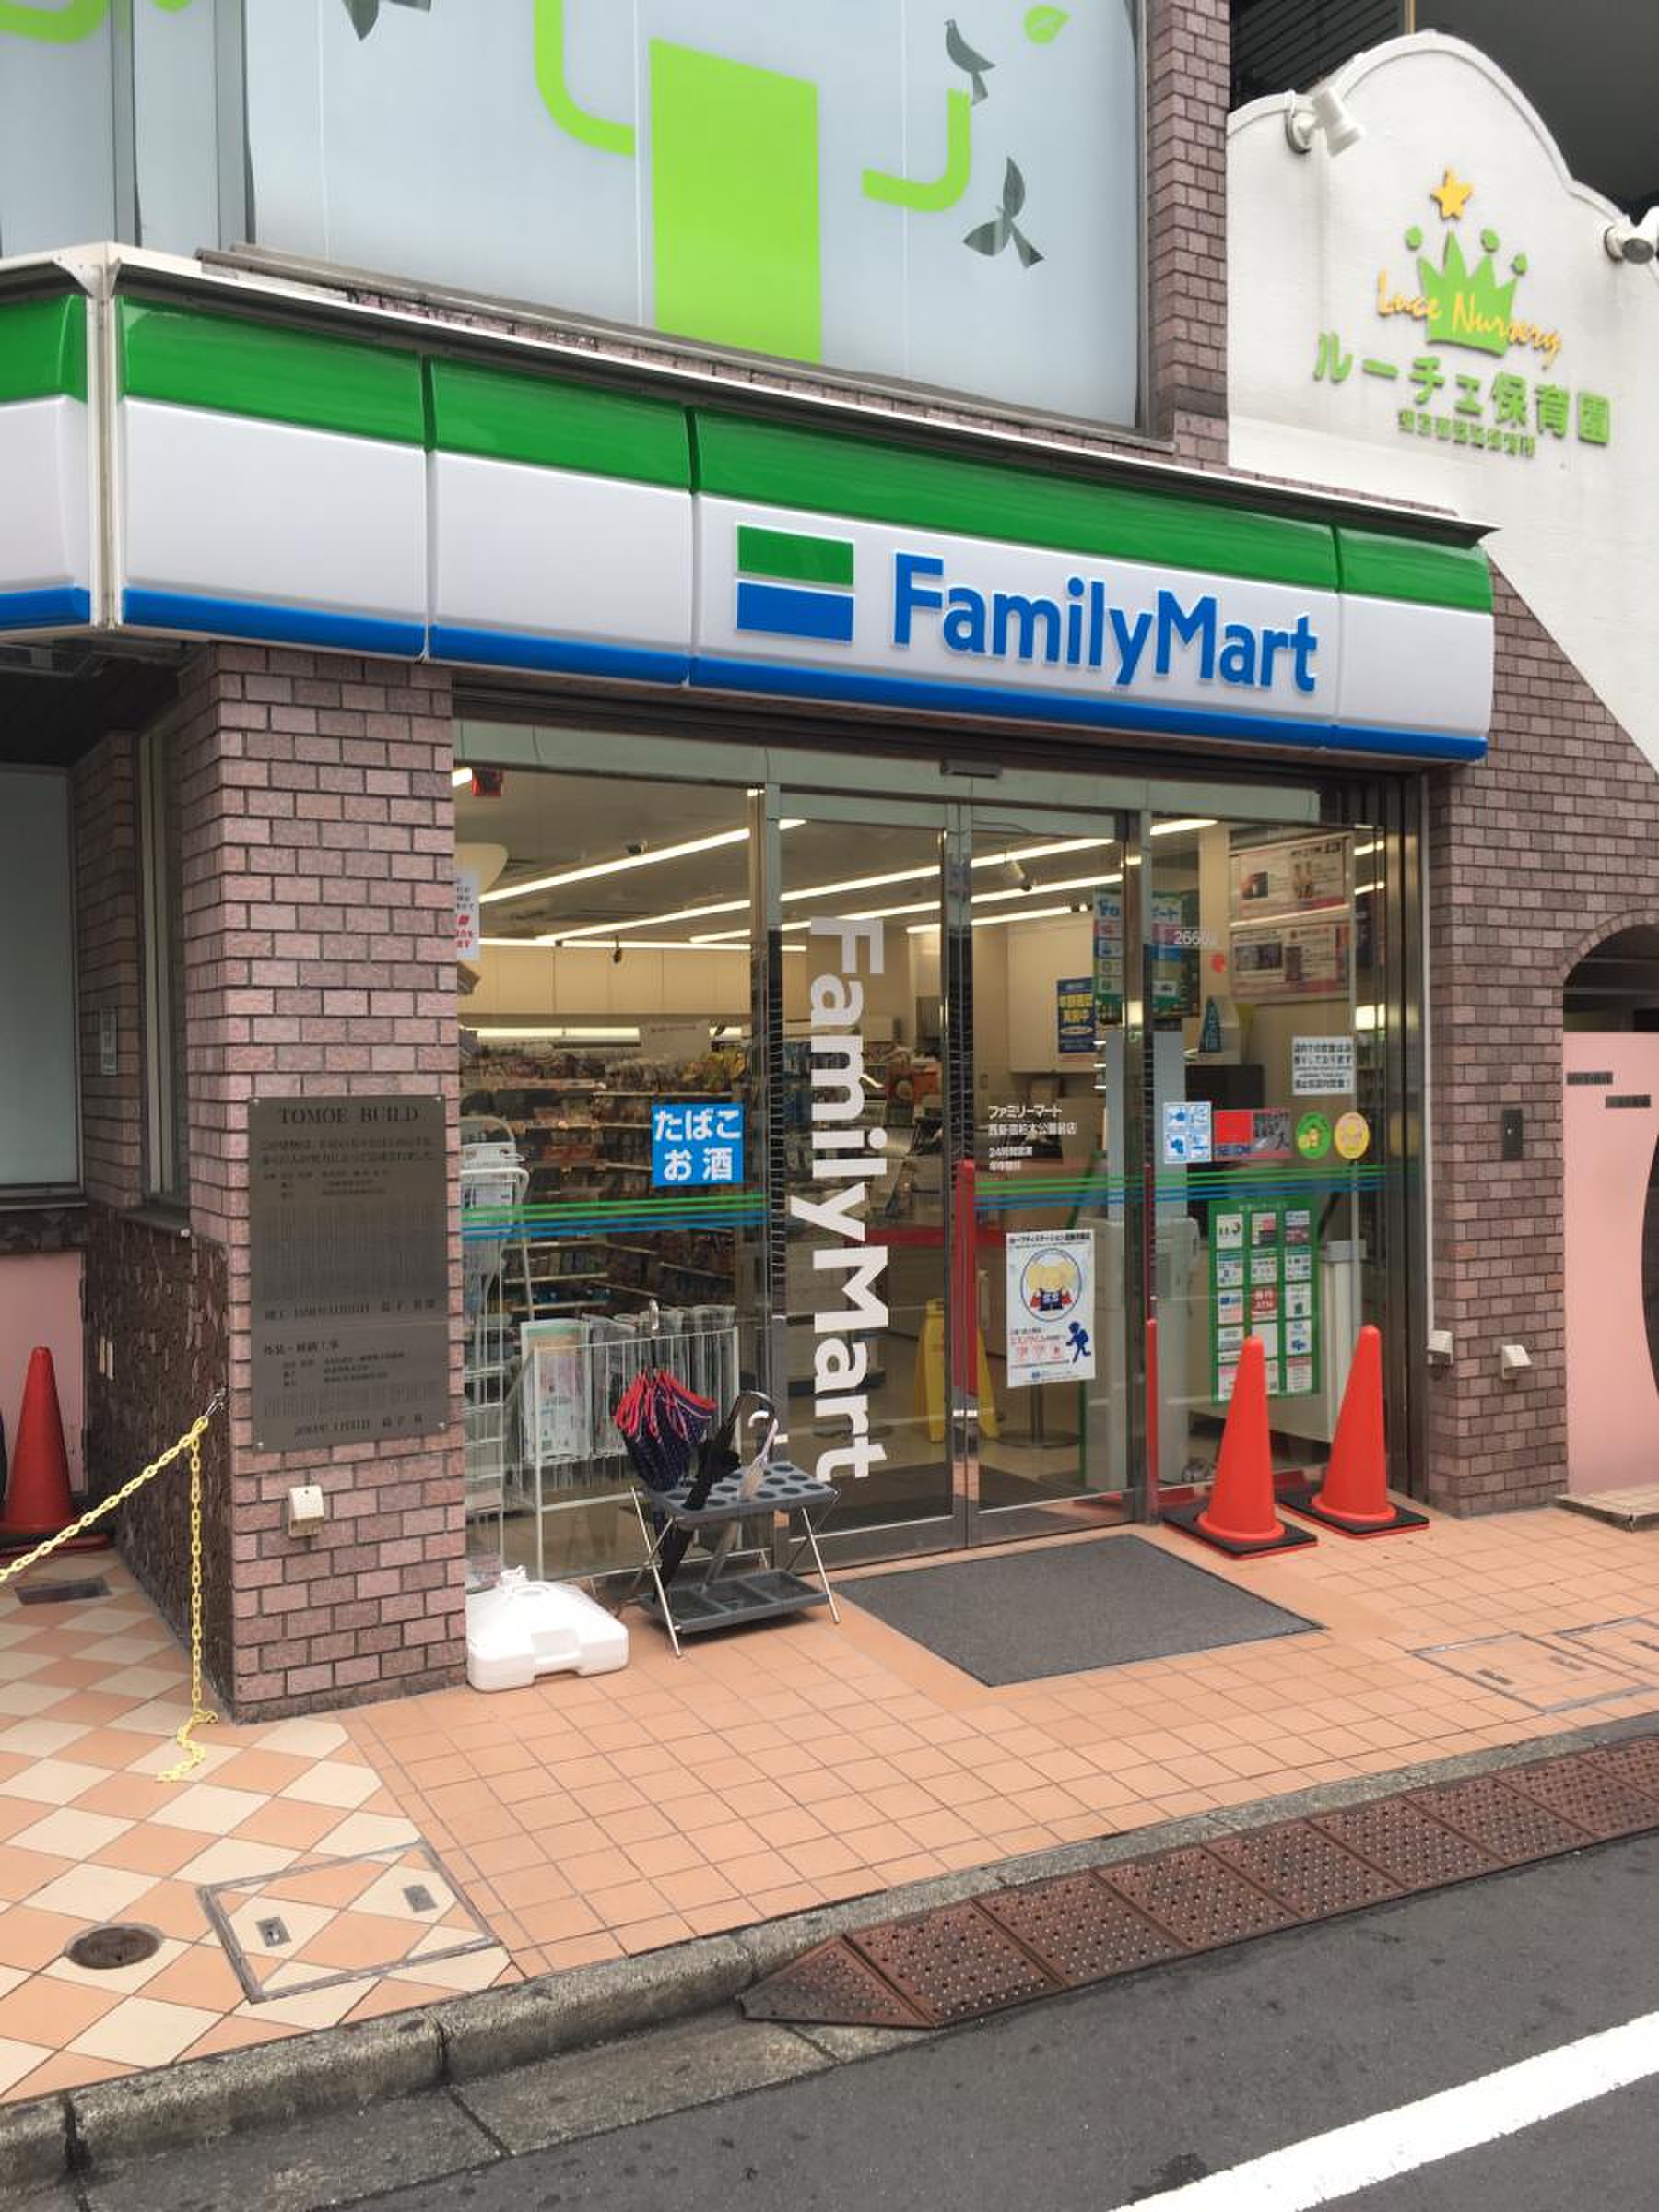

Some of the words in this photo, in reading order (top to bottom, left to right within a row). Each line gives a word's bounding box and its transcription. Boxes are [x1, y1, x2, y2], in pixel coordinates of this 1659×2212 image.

[1313, 332, 1610, 446] ルーチェ保育園
[892, 550, 1318, 693] FamilyMart
[279, 1106, 348, 1124] TOMOE
[360, 1105, 419, 1122] BUILD
[654, 1109, 741, 1142] たばこ
[988, 1104, 1063, 1119] ファミリーマート
[664, 1147, 733, 1181] お酒
[790, 916, 889, 1483] FamilyMart
